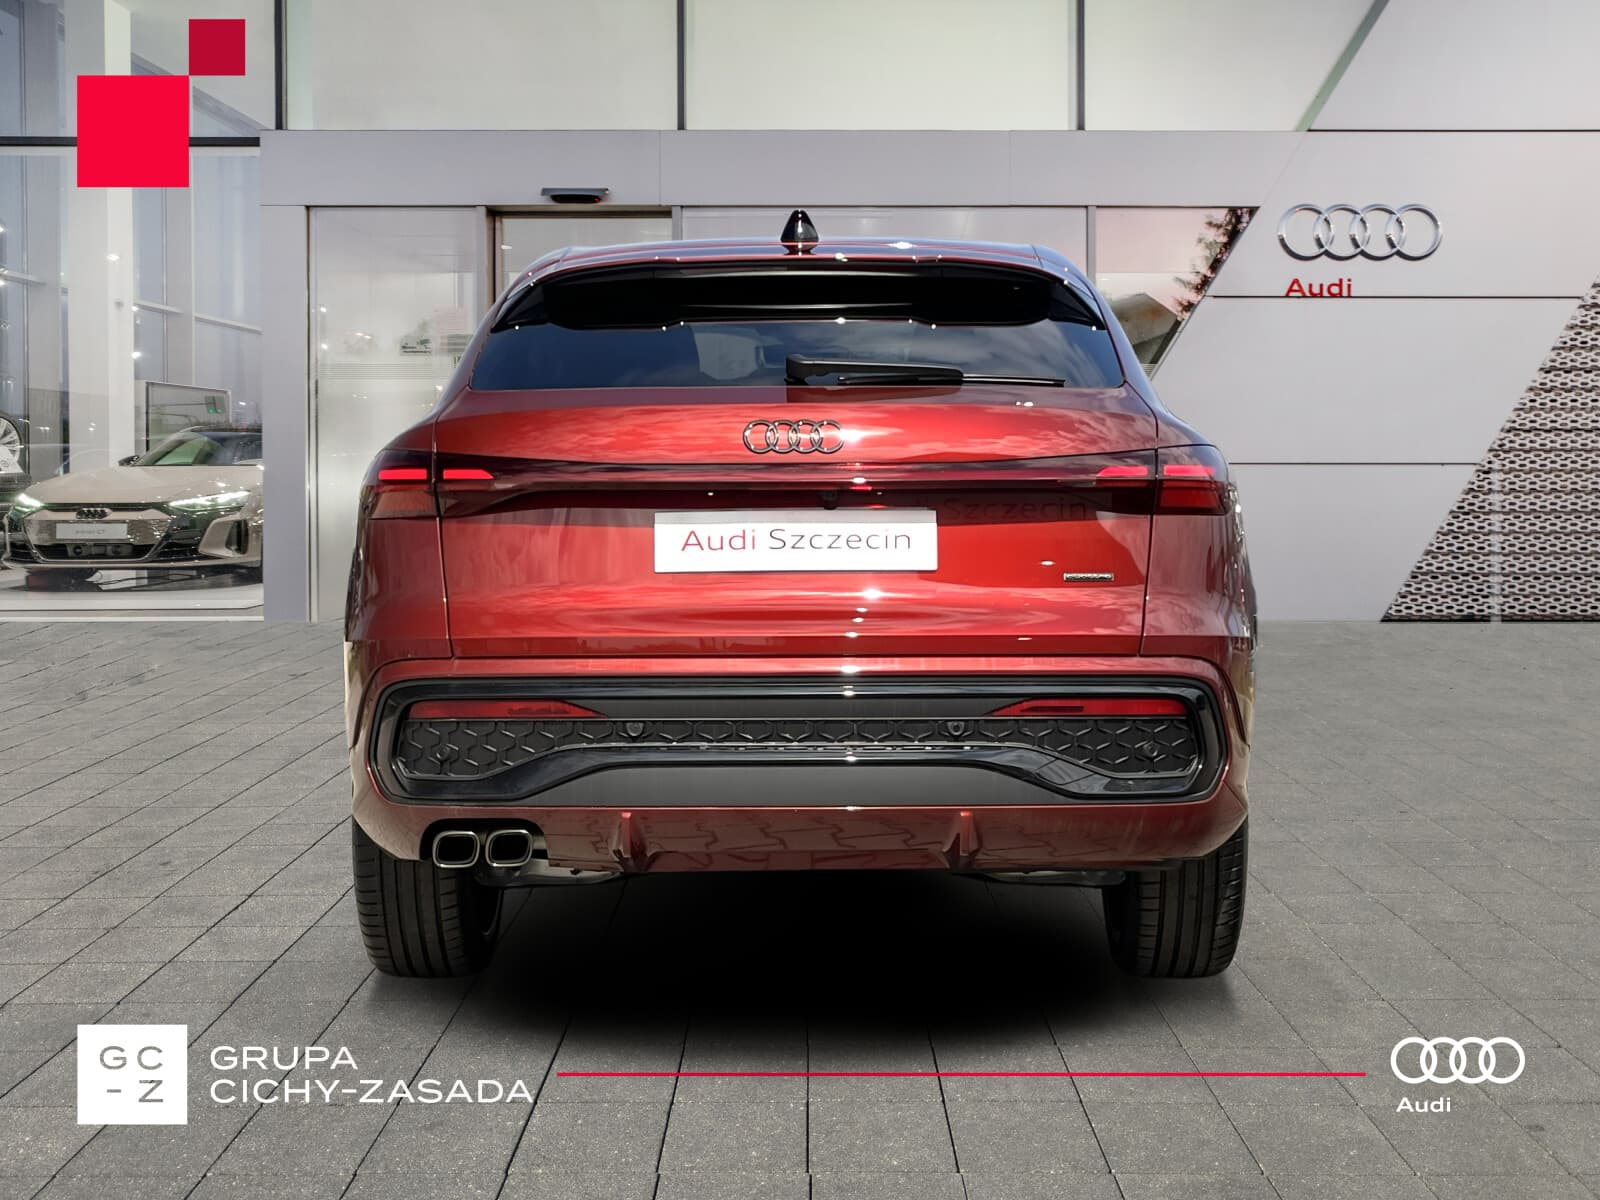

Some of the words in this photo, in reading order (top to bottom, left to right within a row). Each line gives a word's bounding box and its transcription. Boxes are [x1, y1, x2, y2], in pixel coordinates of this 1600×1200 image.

[1285, 278, 1352, 297] Audi
[681, 529, 756, 551] Audi
[768, 528, 911, 550] Szczecin
